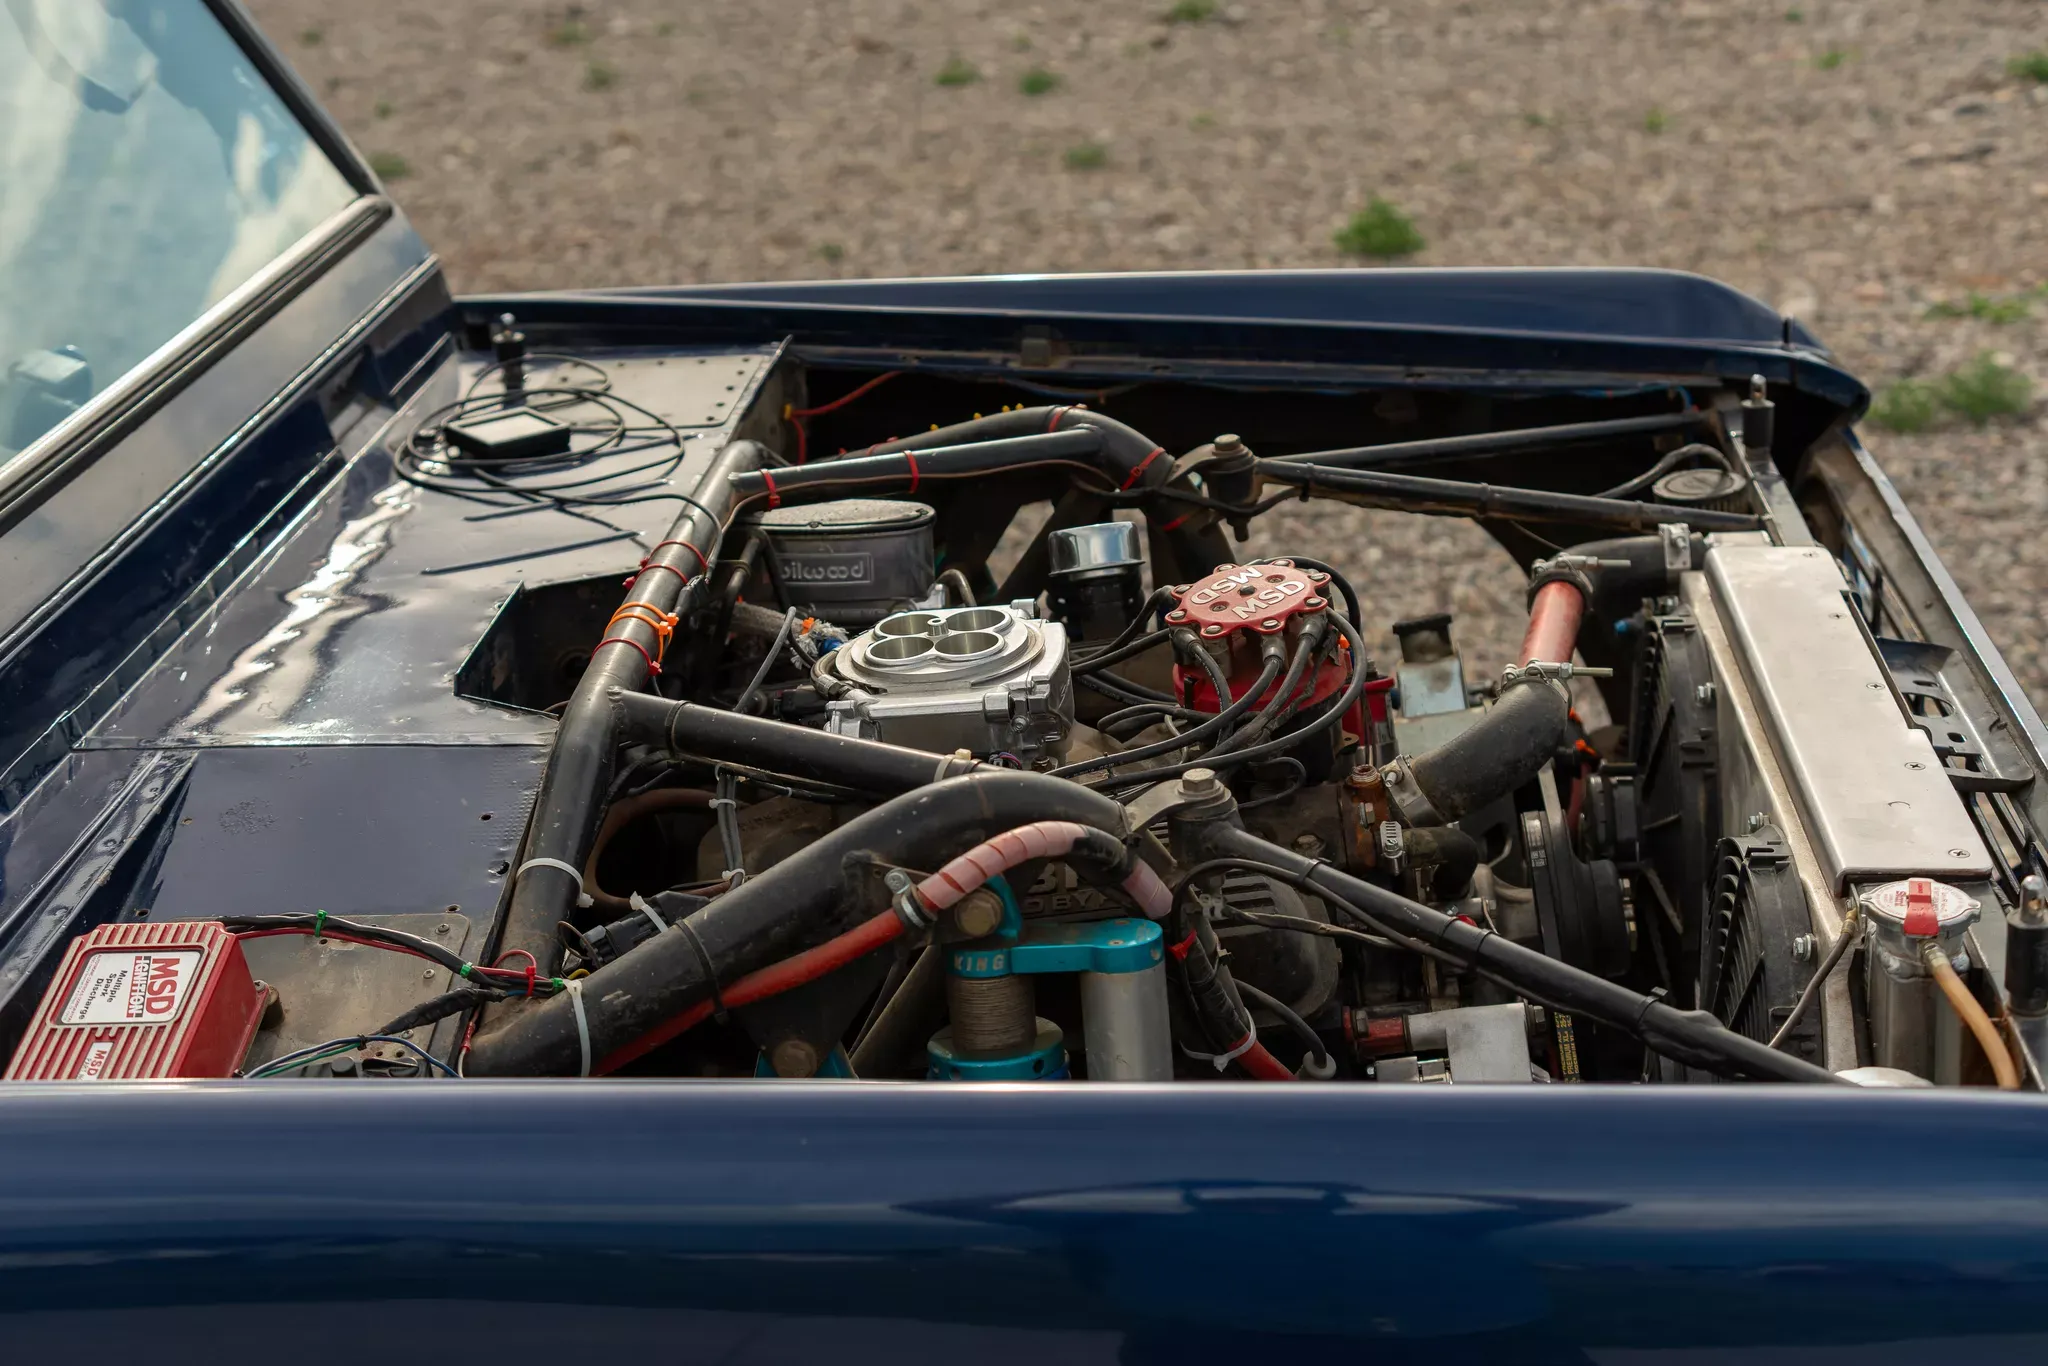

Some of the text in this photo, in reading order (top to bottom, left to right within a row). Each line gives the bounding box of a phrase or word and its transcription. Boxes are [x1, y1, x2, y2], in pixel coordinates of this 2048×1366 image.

[1191, 567, 1264, 605] MSD
[1232, 581, 1305, 620] MSD
[953, 953, 1005, 971] KING
[78, 978, 104, 1020] Discharge
[100, 973, 117, 997] Spark
[106, 970, 128, 1003] Multiple
[127, 957, 151, 1017] IGNITION
[145, 957, 181, 1015] MSD
[86, 1049, 105, 1076] MSD
[1563, 1043, 1574, 1075] PREMIUM
